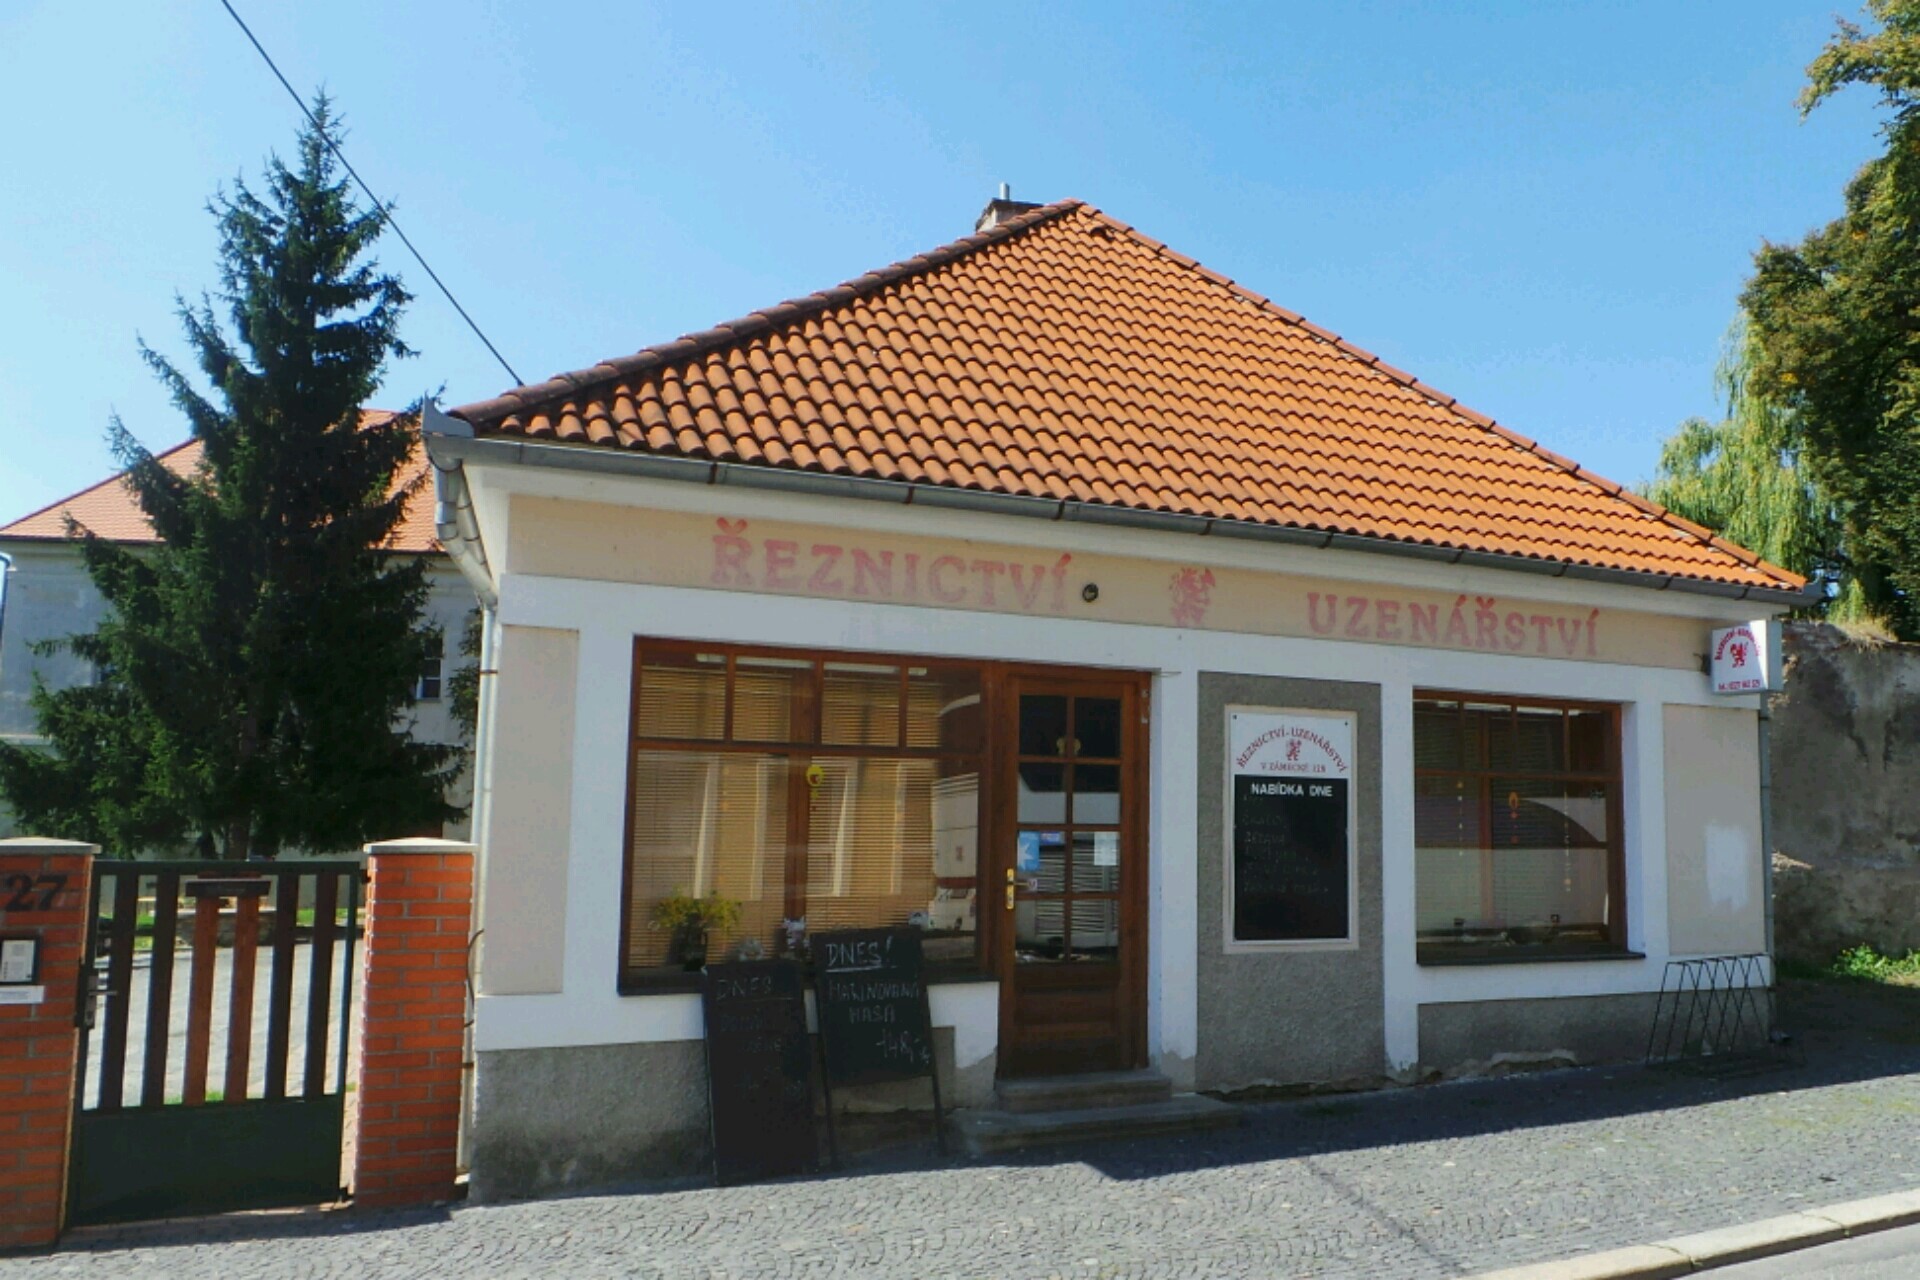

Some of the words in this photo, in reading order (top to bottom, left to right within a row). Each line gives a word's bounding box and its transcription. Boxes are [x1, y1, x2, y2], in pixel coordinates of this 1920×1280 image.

[710, 517, 1072, 612] ŘEZNICTVÍ
[1307, 591, 1600, 656] UZENÁŘSTVÍ
[1251, 782, 1304, 796] NABÍDKA
[1309, 785, 1333, 797] DNE
[6, 874, 67, 911] 27
